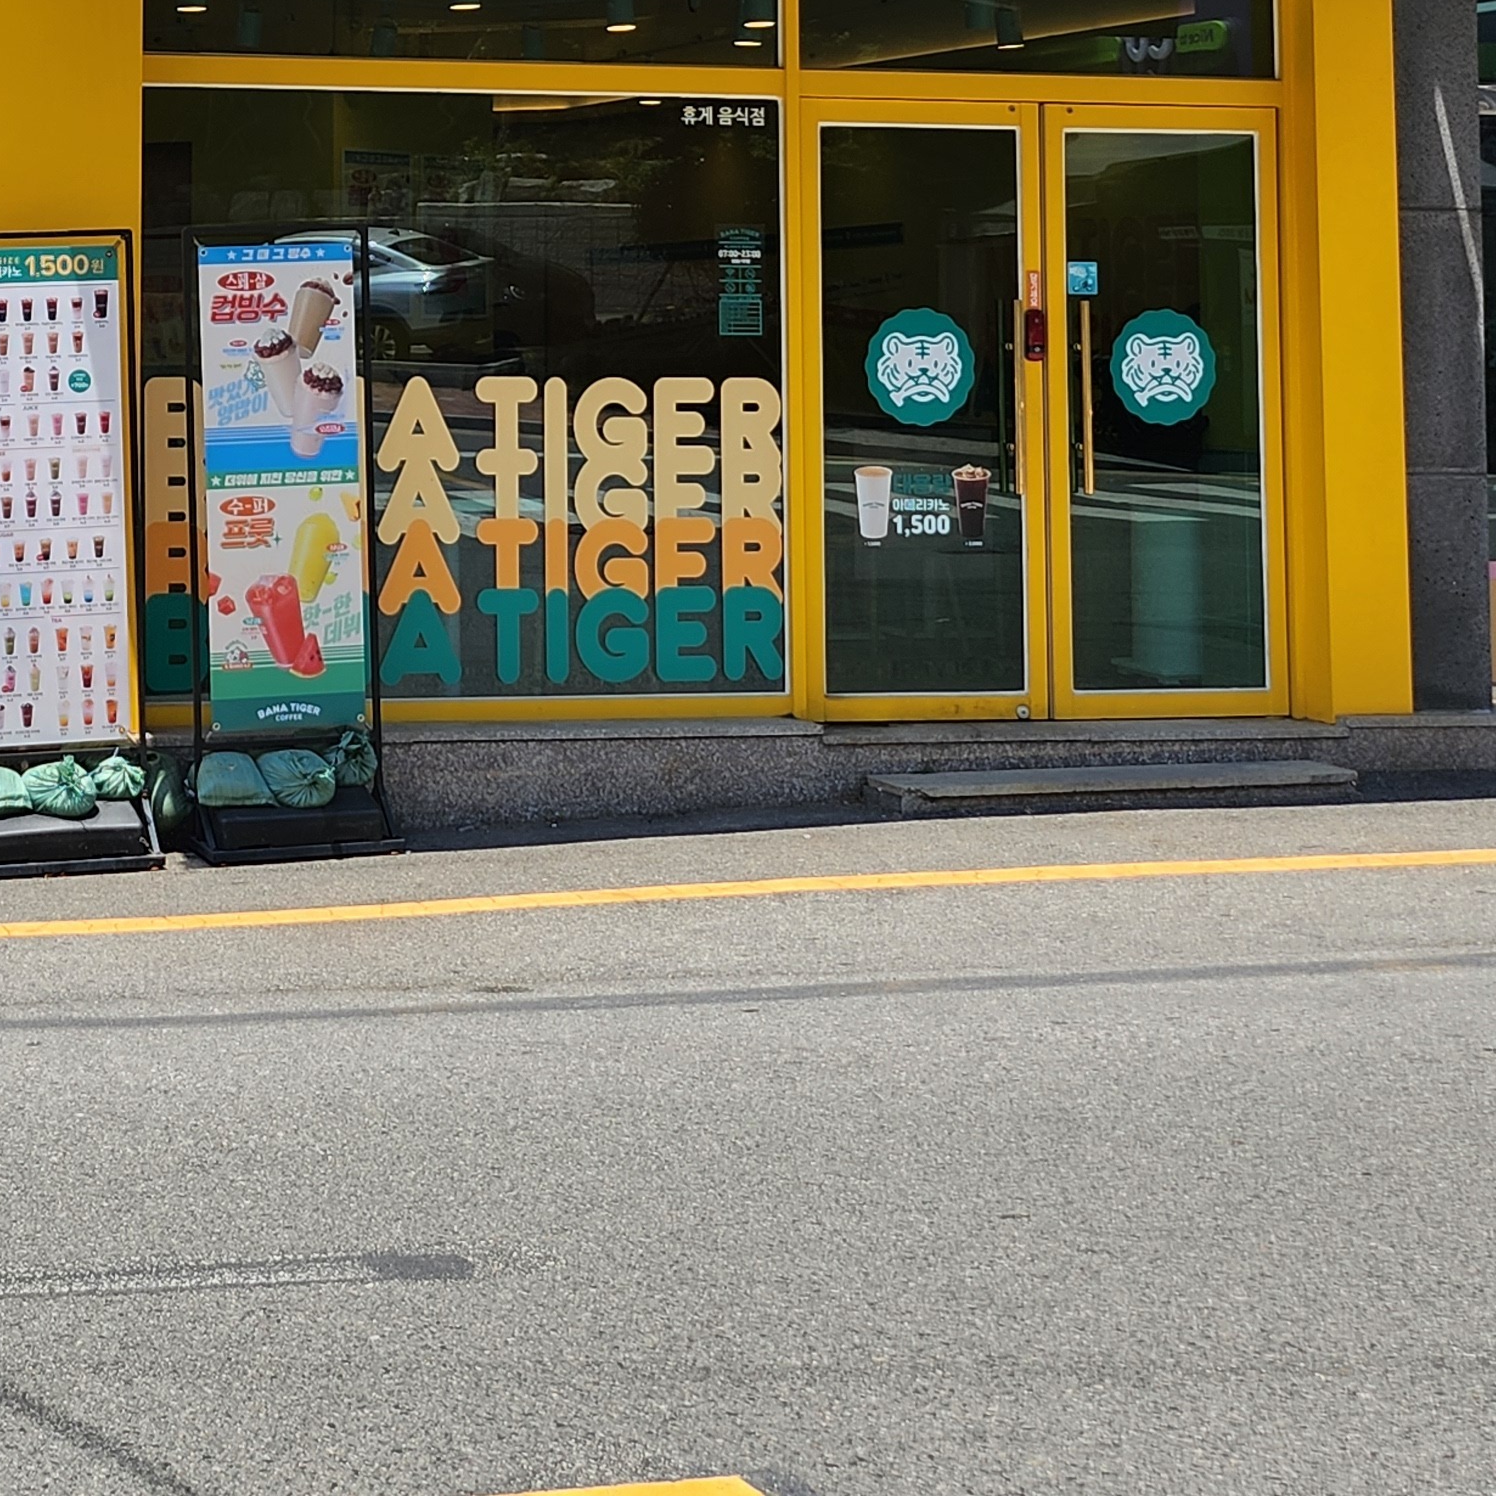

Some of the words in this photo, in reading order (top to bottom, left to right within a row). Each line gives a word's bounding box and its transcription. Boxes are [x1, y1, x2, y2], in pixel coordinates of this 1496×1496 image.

[681, 106, 713, 125] 휴게
[717, 107, 765, 126] 음식점
[91, 258, 104, 273] 원
[211, 292, 288, 324] 컵빙수
[227, 498, 269, 515] 수-퍼
[892, 514, 951, 537] 1,500
[477, 586, 784, 684] TIGER
[257, 703, 289, 720] BANA
[290, 702, 321, 717] TIGER
[275, 713, 303, 722] COFFEE
